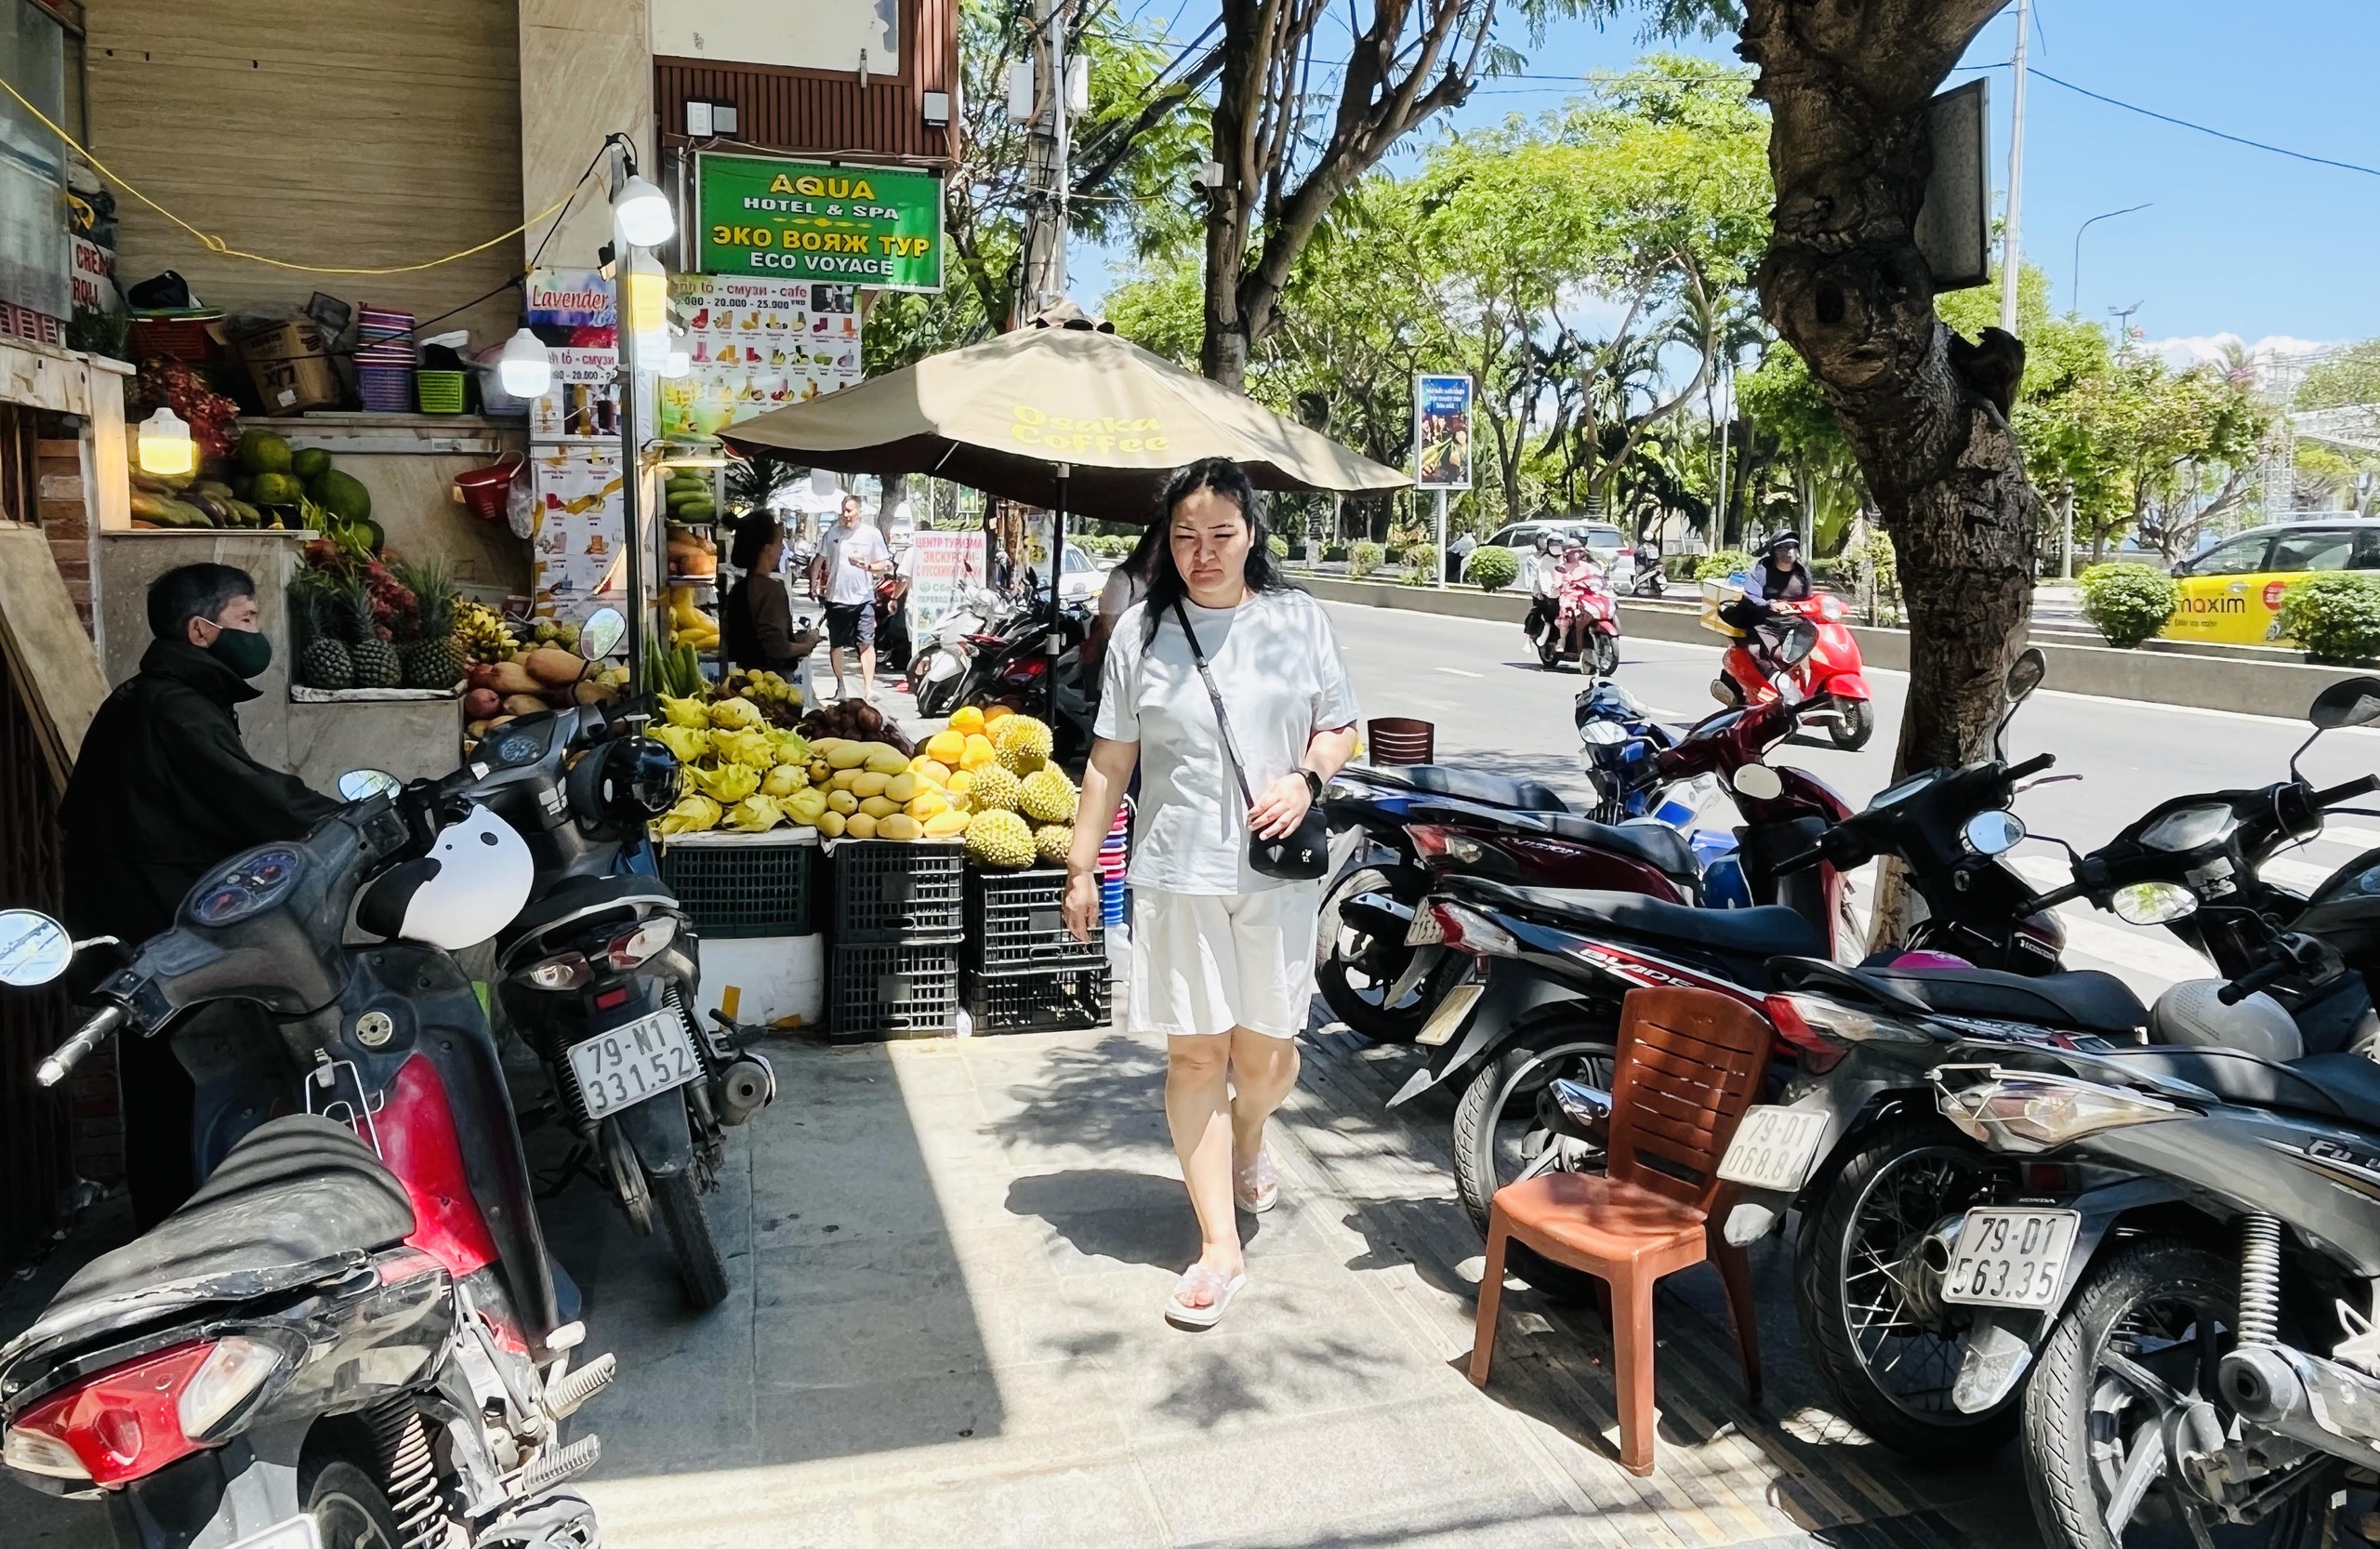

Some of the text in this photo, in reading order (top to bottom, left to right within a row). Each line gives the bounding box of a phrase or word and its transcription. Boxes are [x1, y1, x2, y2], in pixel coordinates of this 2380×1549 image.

[770, 174, 876, 200] AQUA
[744, 197, 900, 220] HOTEL & SPA
[712, 225, 930, 257] ЭКО ВОЯЖ ТУР
[750, 252, 893, 275] ECO VOYAGE
[533, 285, 609, 311] Lavender
[1012, 404, 1161, 434] Osaka
[1011, 422, 1170, 456] Coffee
[587, 1019, 667, 1074] 79-N1
[588, 1047, 692, 1109] 331.52
[1974, 1217, 2057, 1255] 79-D1
[1951, 1257, 2058, 1300] 563.35
